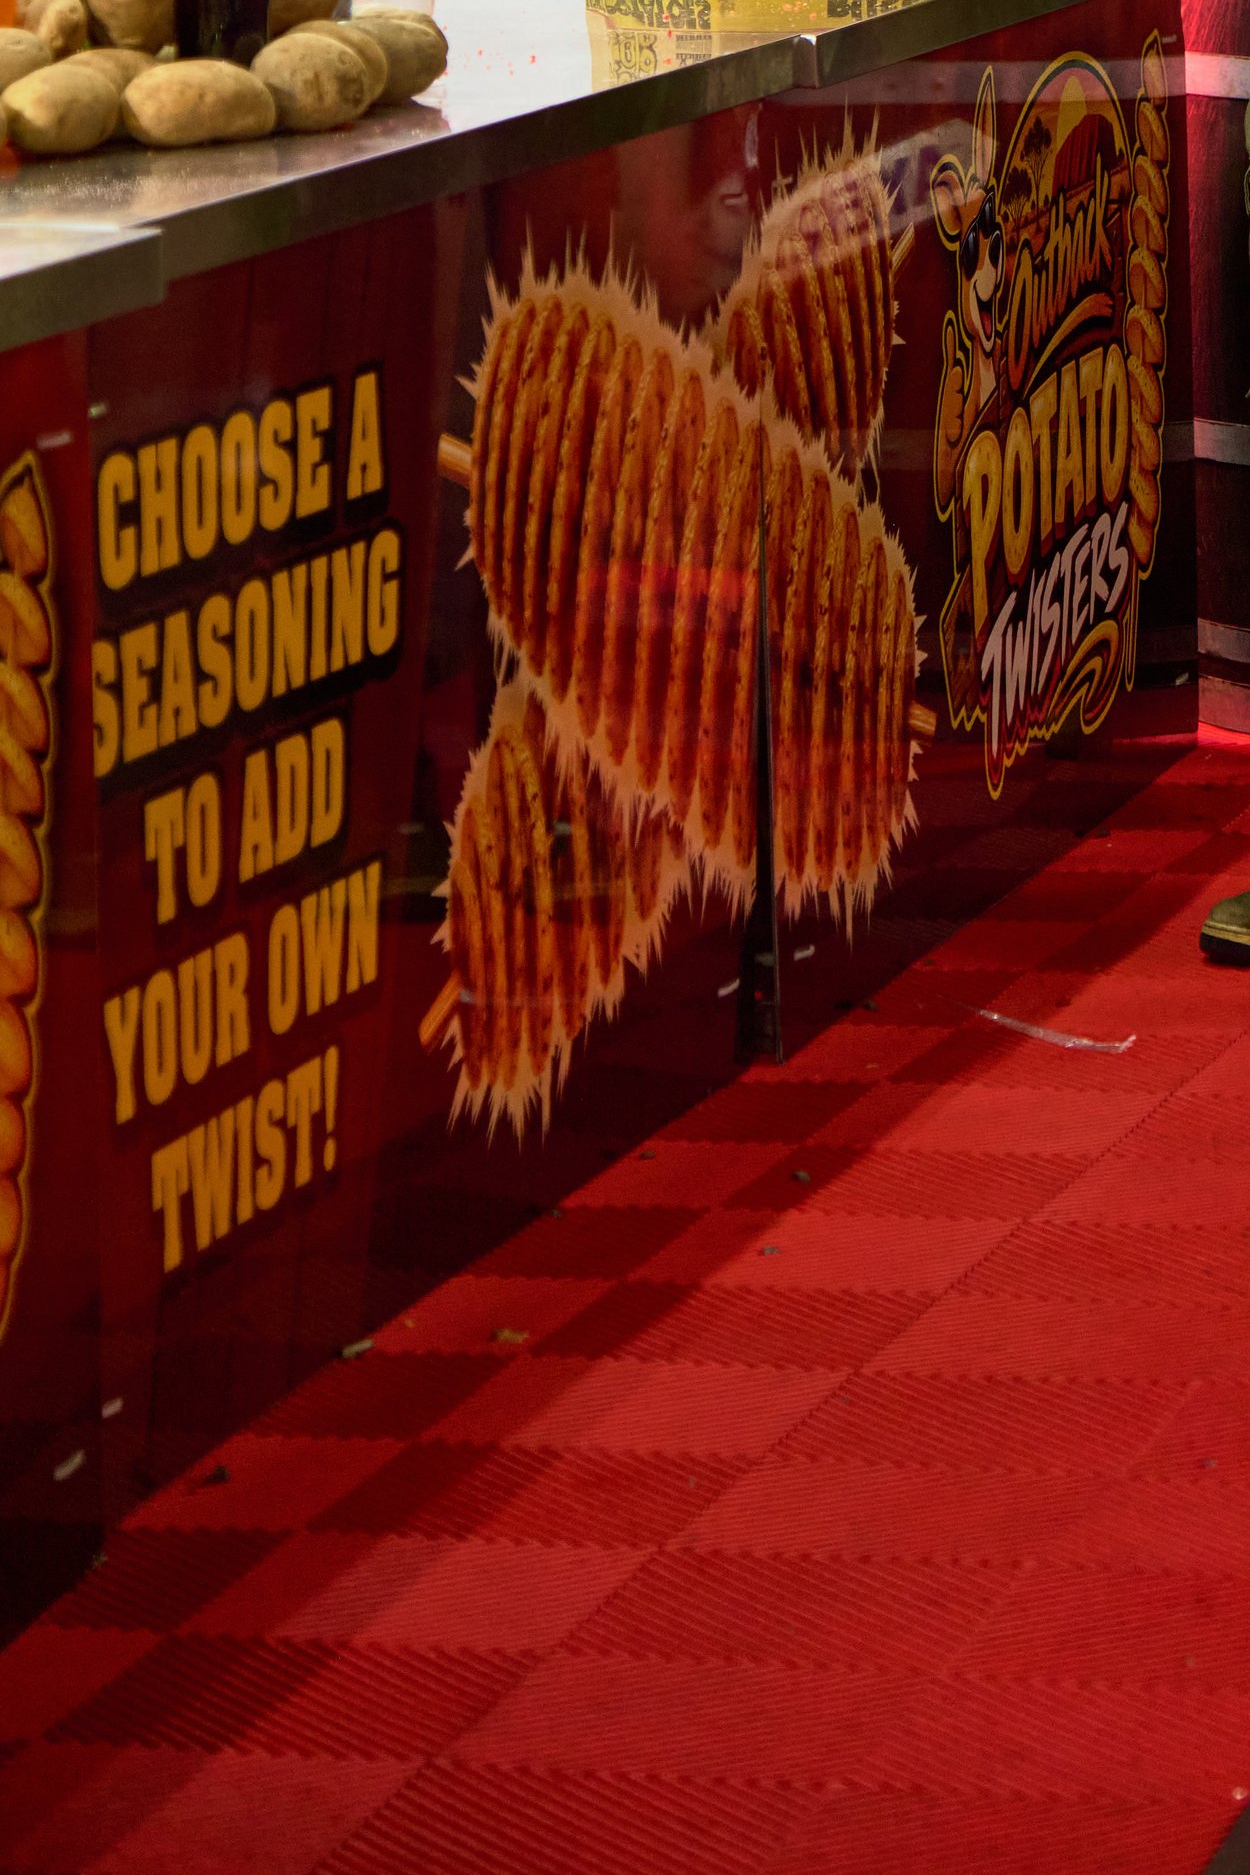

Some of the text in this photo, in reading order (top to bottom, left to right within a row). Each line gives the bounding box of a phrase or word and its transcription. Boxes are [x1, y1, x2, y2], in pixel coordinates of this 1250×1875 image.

[1008, 152, 1120, 381] Outback
[96, 370, 385, 592] CHOOSE A
[964, 343, 1130, 630] POTATO
[90, 528, 402, 780] SEASONING
[980, 502, 1130, 753] TWISTERS
[144, 716, 346, 925] TO ADD
[103, 861, 383, 1127] YOUR OWN
[150, 1044, 341, 1274] TWIST!
